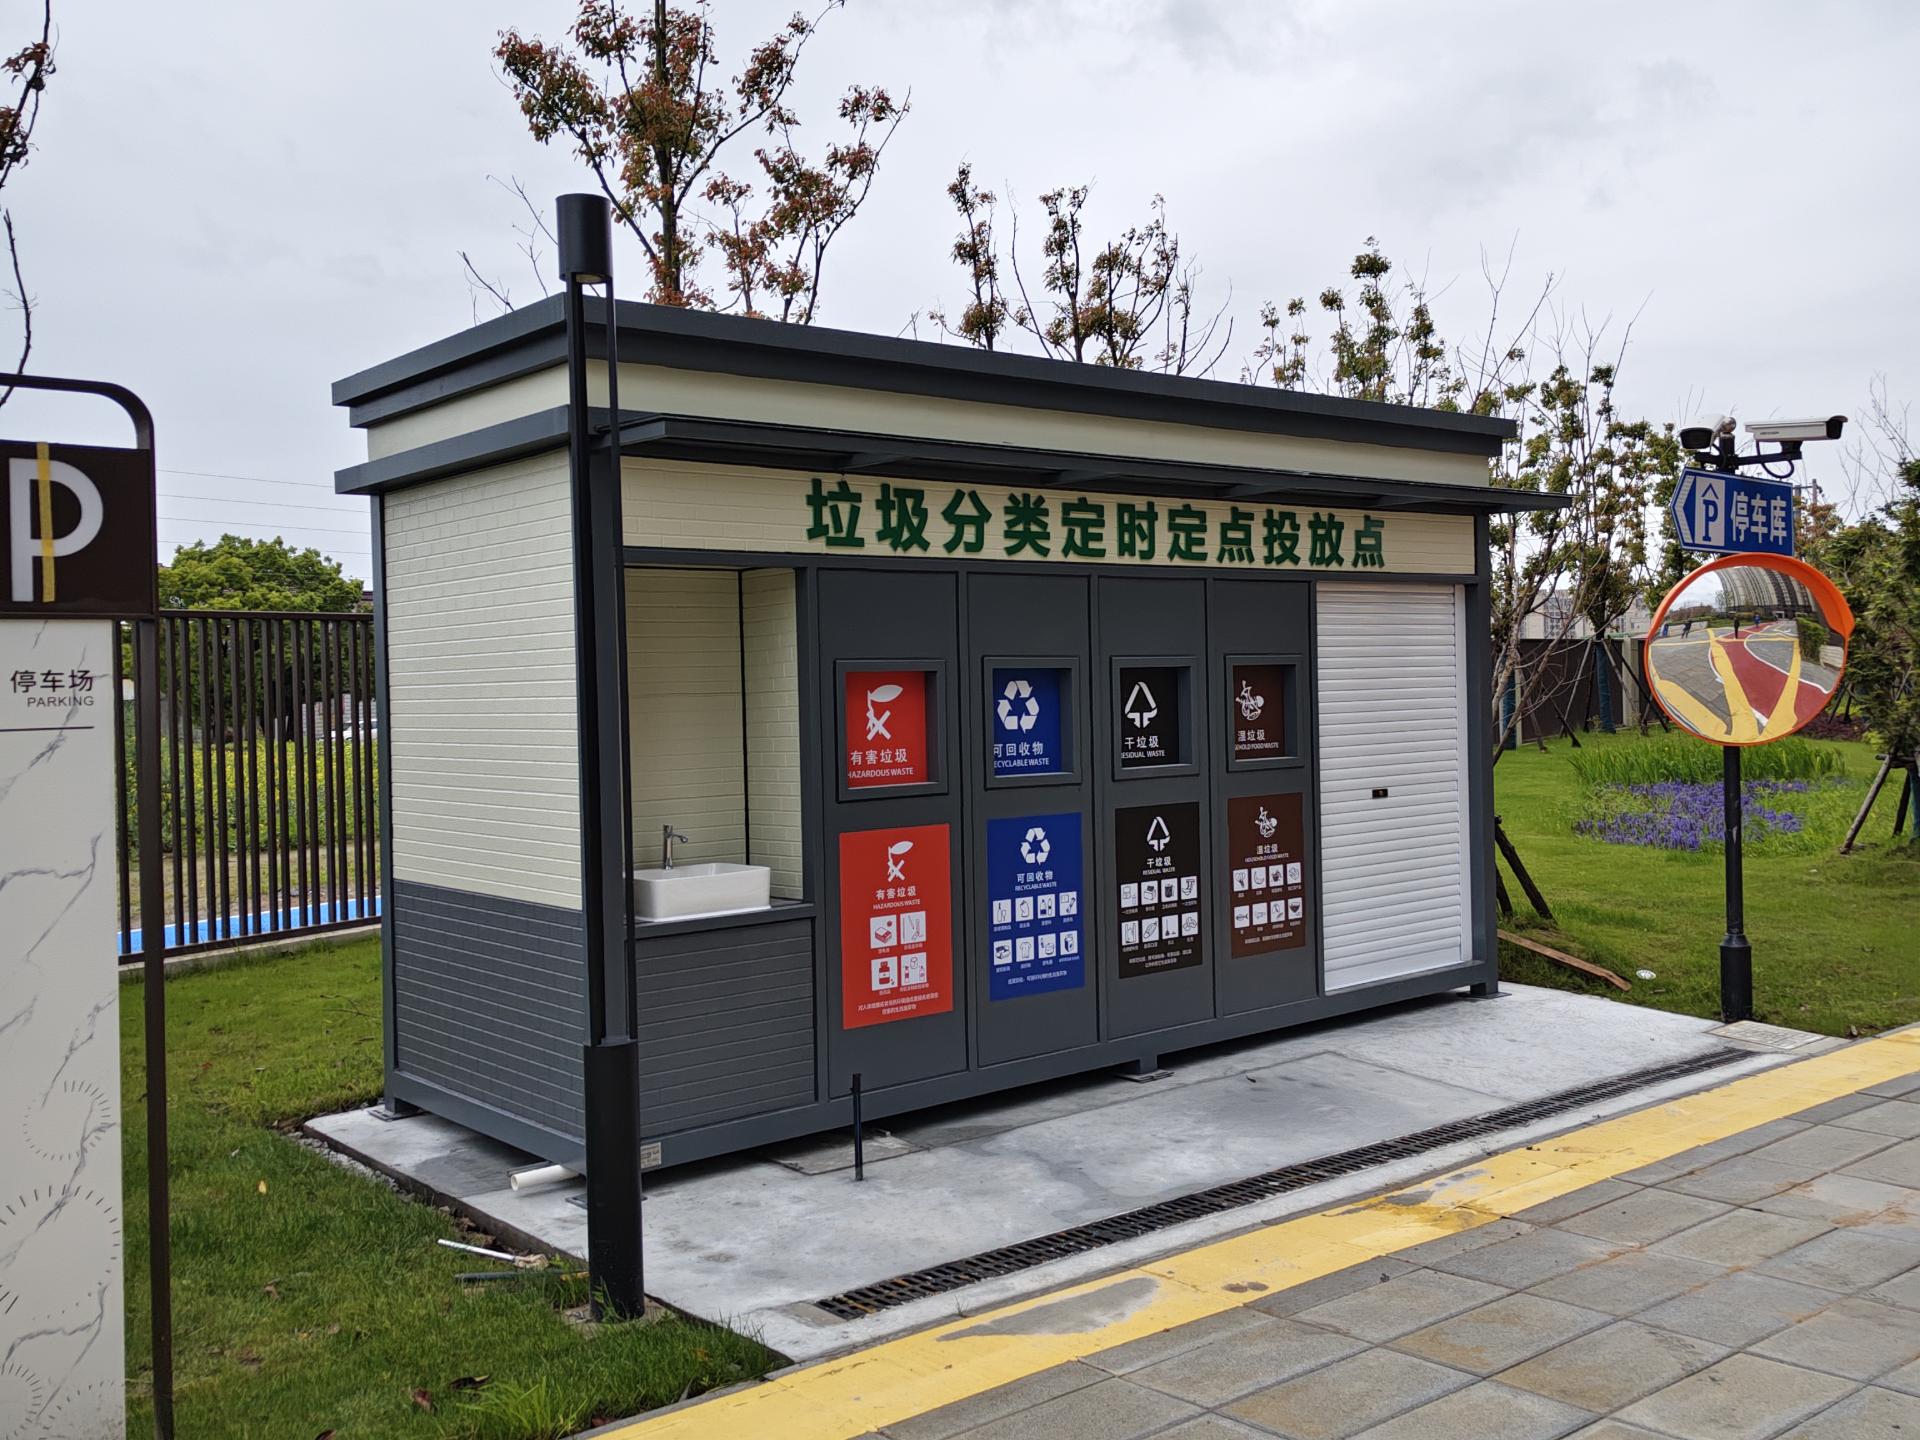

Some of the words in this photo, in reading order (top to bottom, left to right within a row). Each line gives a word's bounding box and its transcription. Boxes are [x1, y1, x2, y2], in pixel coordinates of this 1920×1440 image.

[805, 477, 1386, 569] 垃圾分类定时定点投放点
[1702, 499, 1718, 542] P
[1730, 490, 1787, 546] 停车库
[9, 457, 104, 602] P
[10, 668, 94, 694] 停车场
[27, 695, 95, 708] PARKING
[1124, 735, 1159, 750] 干垃圾
[1237, 729, 1266, 742] 湿垃圾
[850, 748, 908, 766] 有害垃圾
[993, 741, 1043, 758] 可回收物
[1146, 749, 1166, 758] WASTE
[993, 759, 1028, 768] ECYCLABLE
[1028, 757, 1050, 766] WASTE
[890, 767, 914, 776] WASTE
[1146, 856, 1172, 869] 干垃圾
[1016, 870, 1054, 884] 可回收物
[875, 885, 917, 900] 有害垃圾
